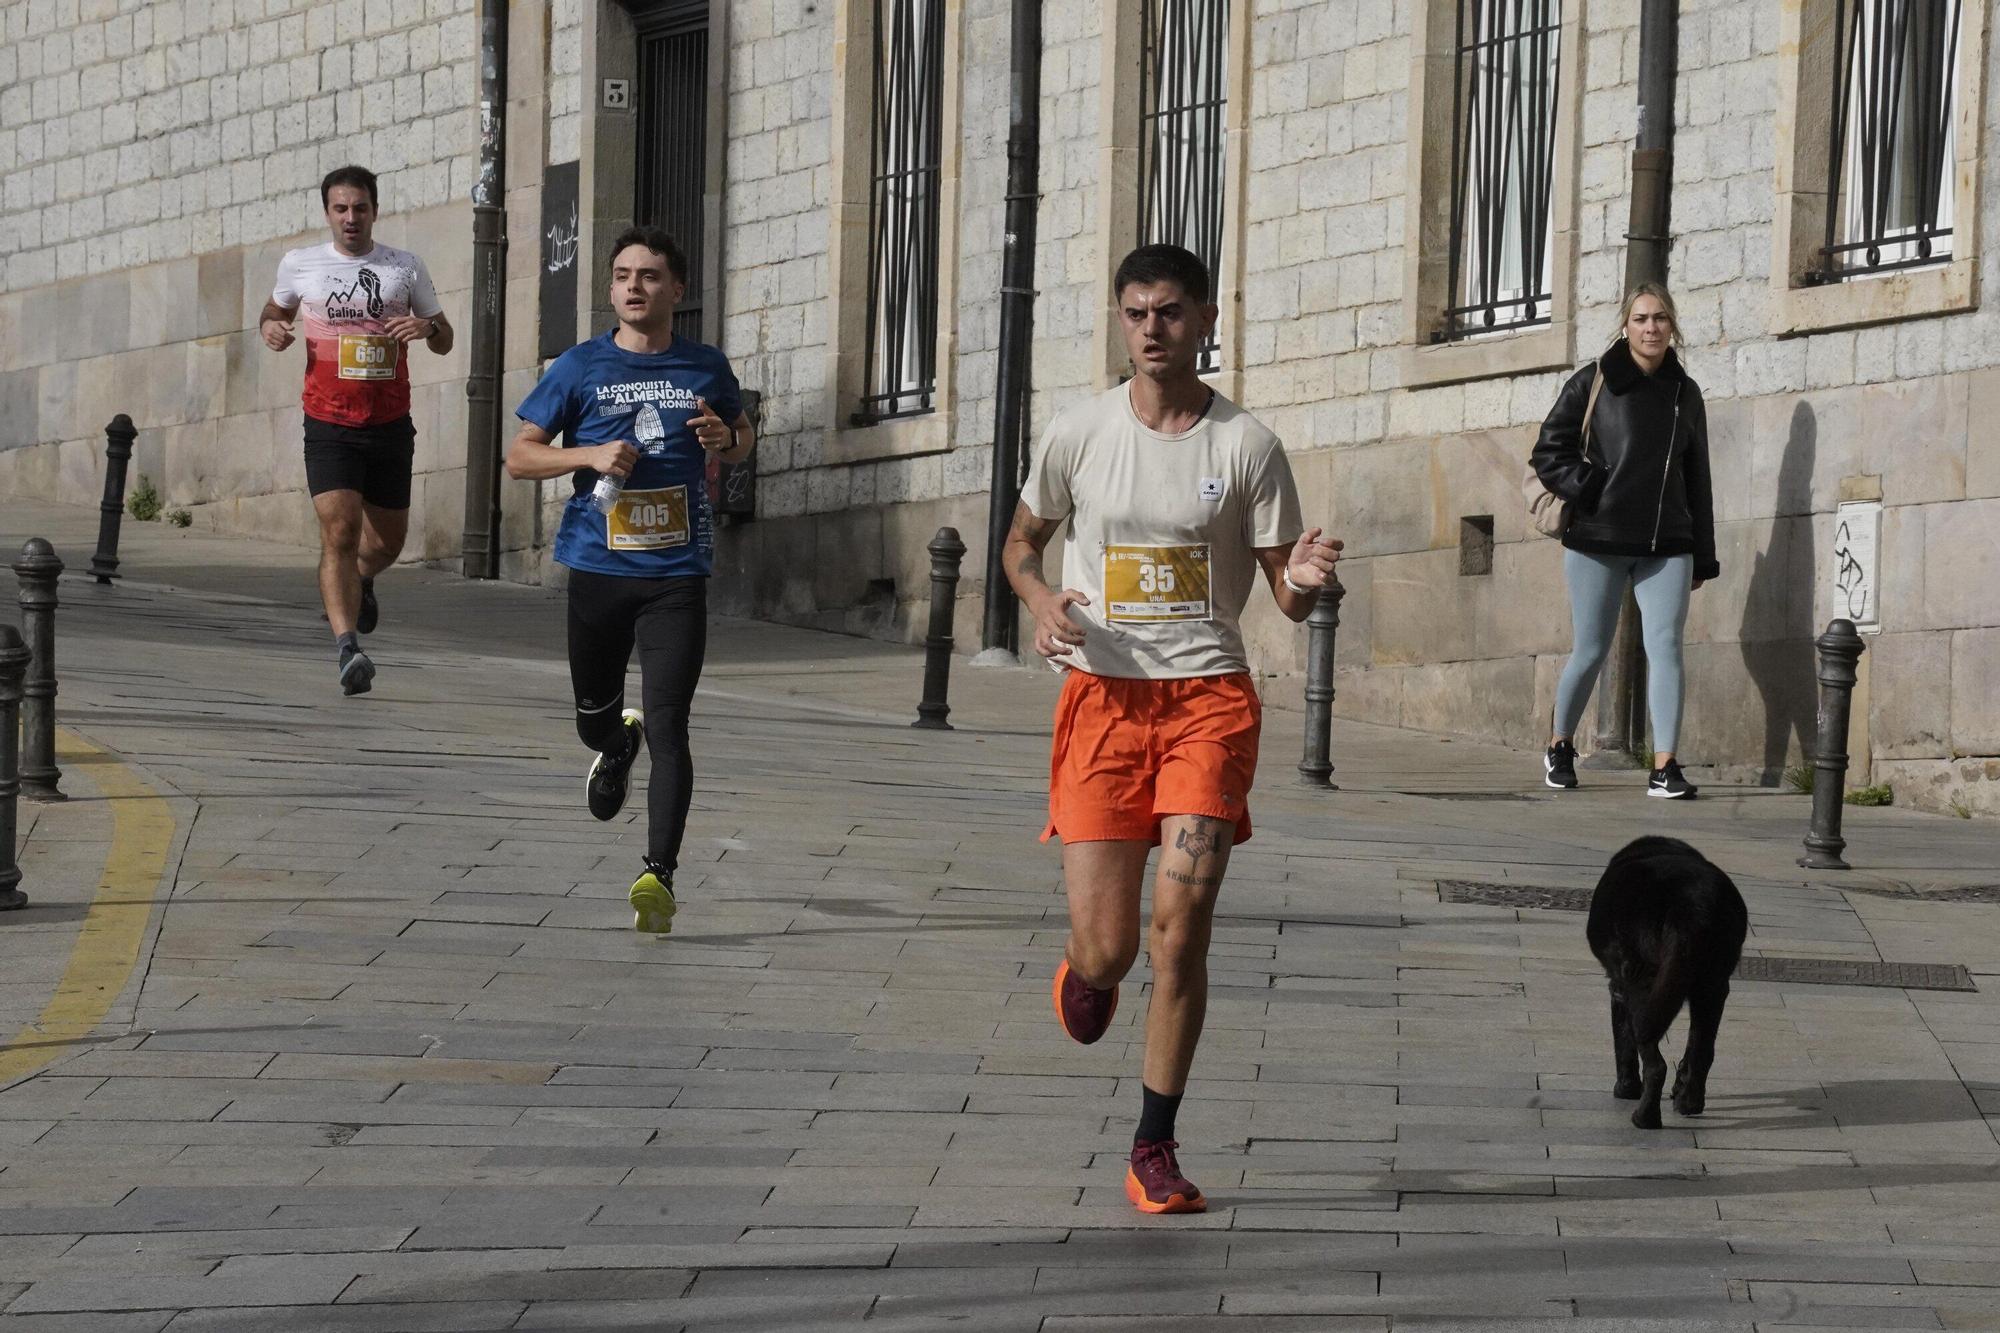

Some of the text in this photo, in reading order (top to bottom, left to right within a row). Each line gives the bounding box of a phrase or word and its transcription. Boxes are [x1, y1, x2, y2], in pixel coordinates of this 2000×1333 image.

[327, 307, 364, 319] Galipa
[355, 346, 385, 363] 650
[596, 380, 673, 395] LA CONQUISTA
[614, 389, 694, 404] ALMENDRA
[629, 503, 670, 528] 405
[1190, 551, 1204, 559] 10K
[1139, 564, 1175, 593] 35
